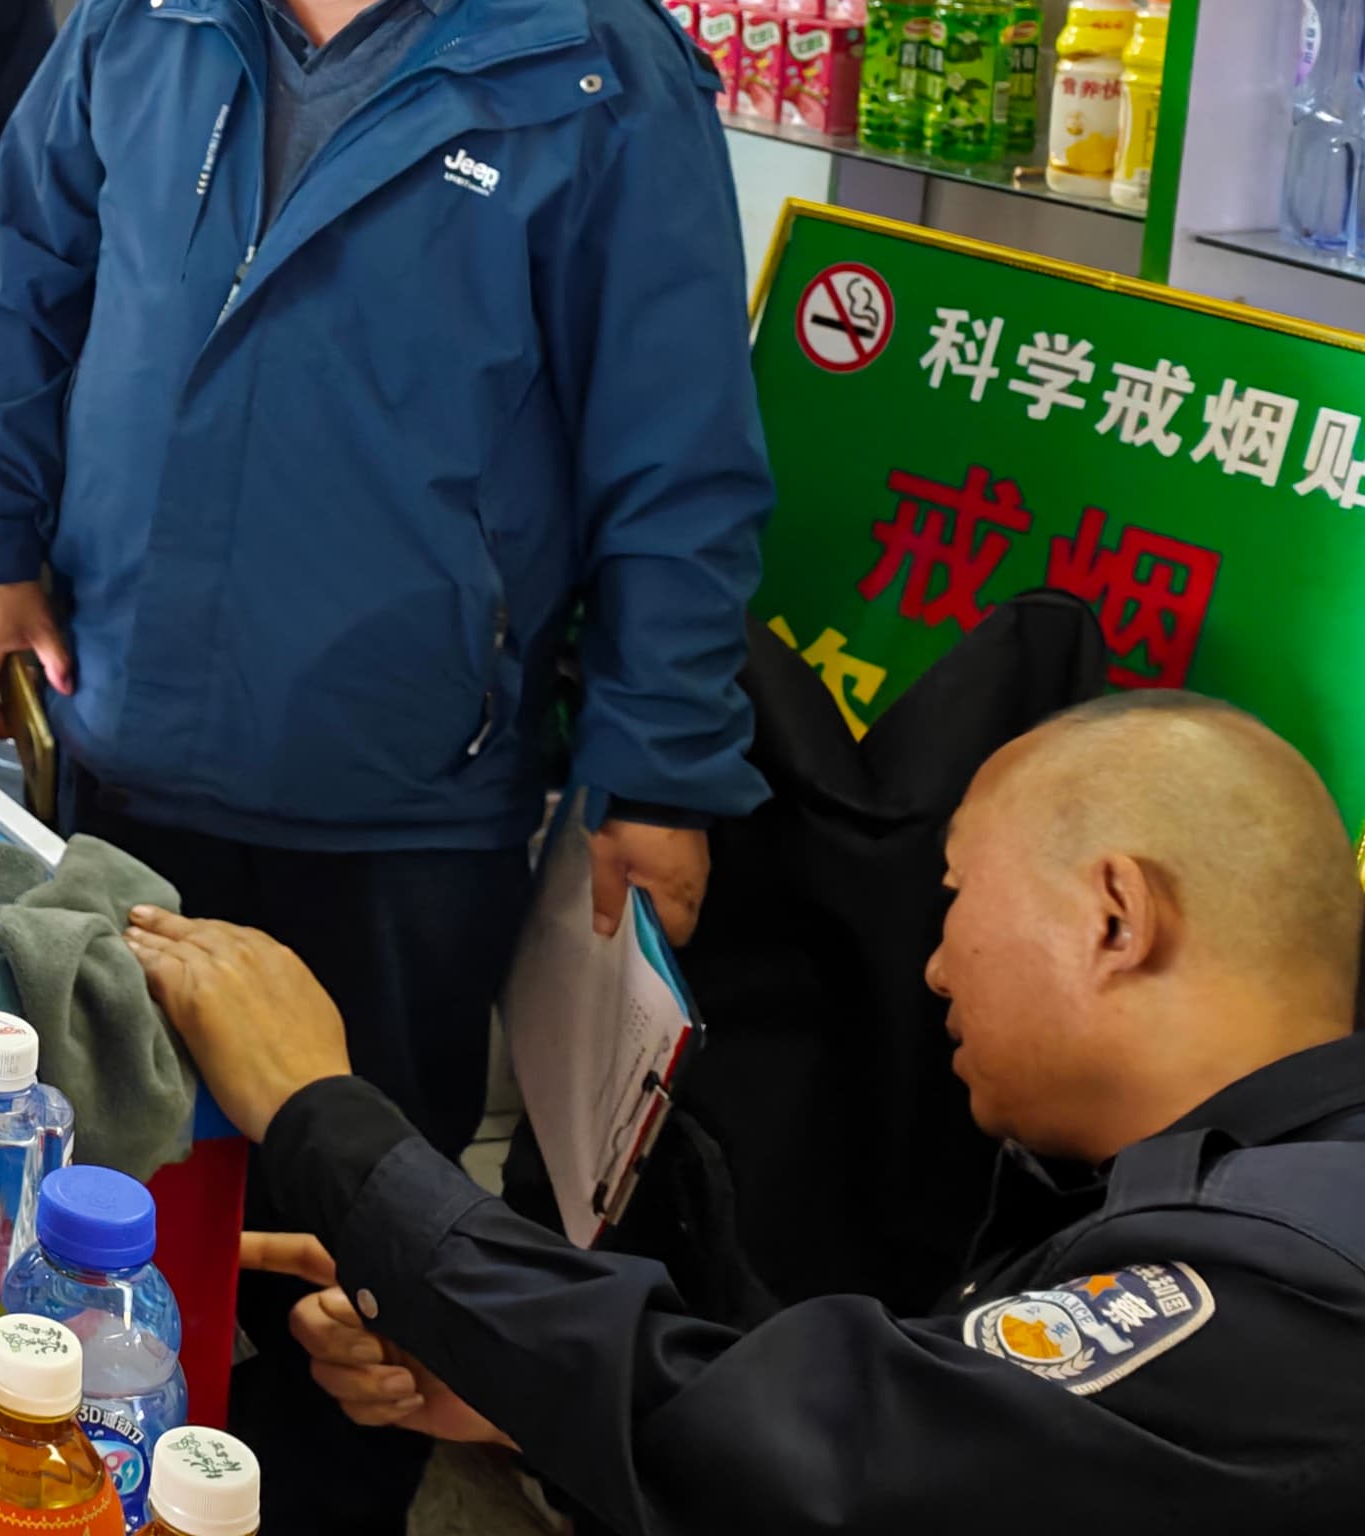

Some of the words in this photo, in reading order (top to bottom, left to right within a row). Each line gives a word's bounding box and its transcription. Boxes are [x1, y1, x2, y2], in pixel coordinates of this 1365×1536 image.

[444, 148, 500, 190] Jeep
[919, 306, 1365, 510] 科学戒烟贴
[857, 464, 1223, 690] 戒烟
